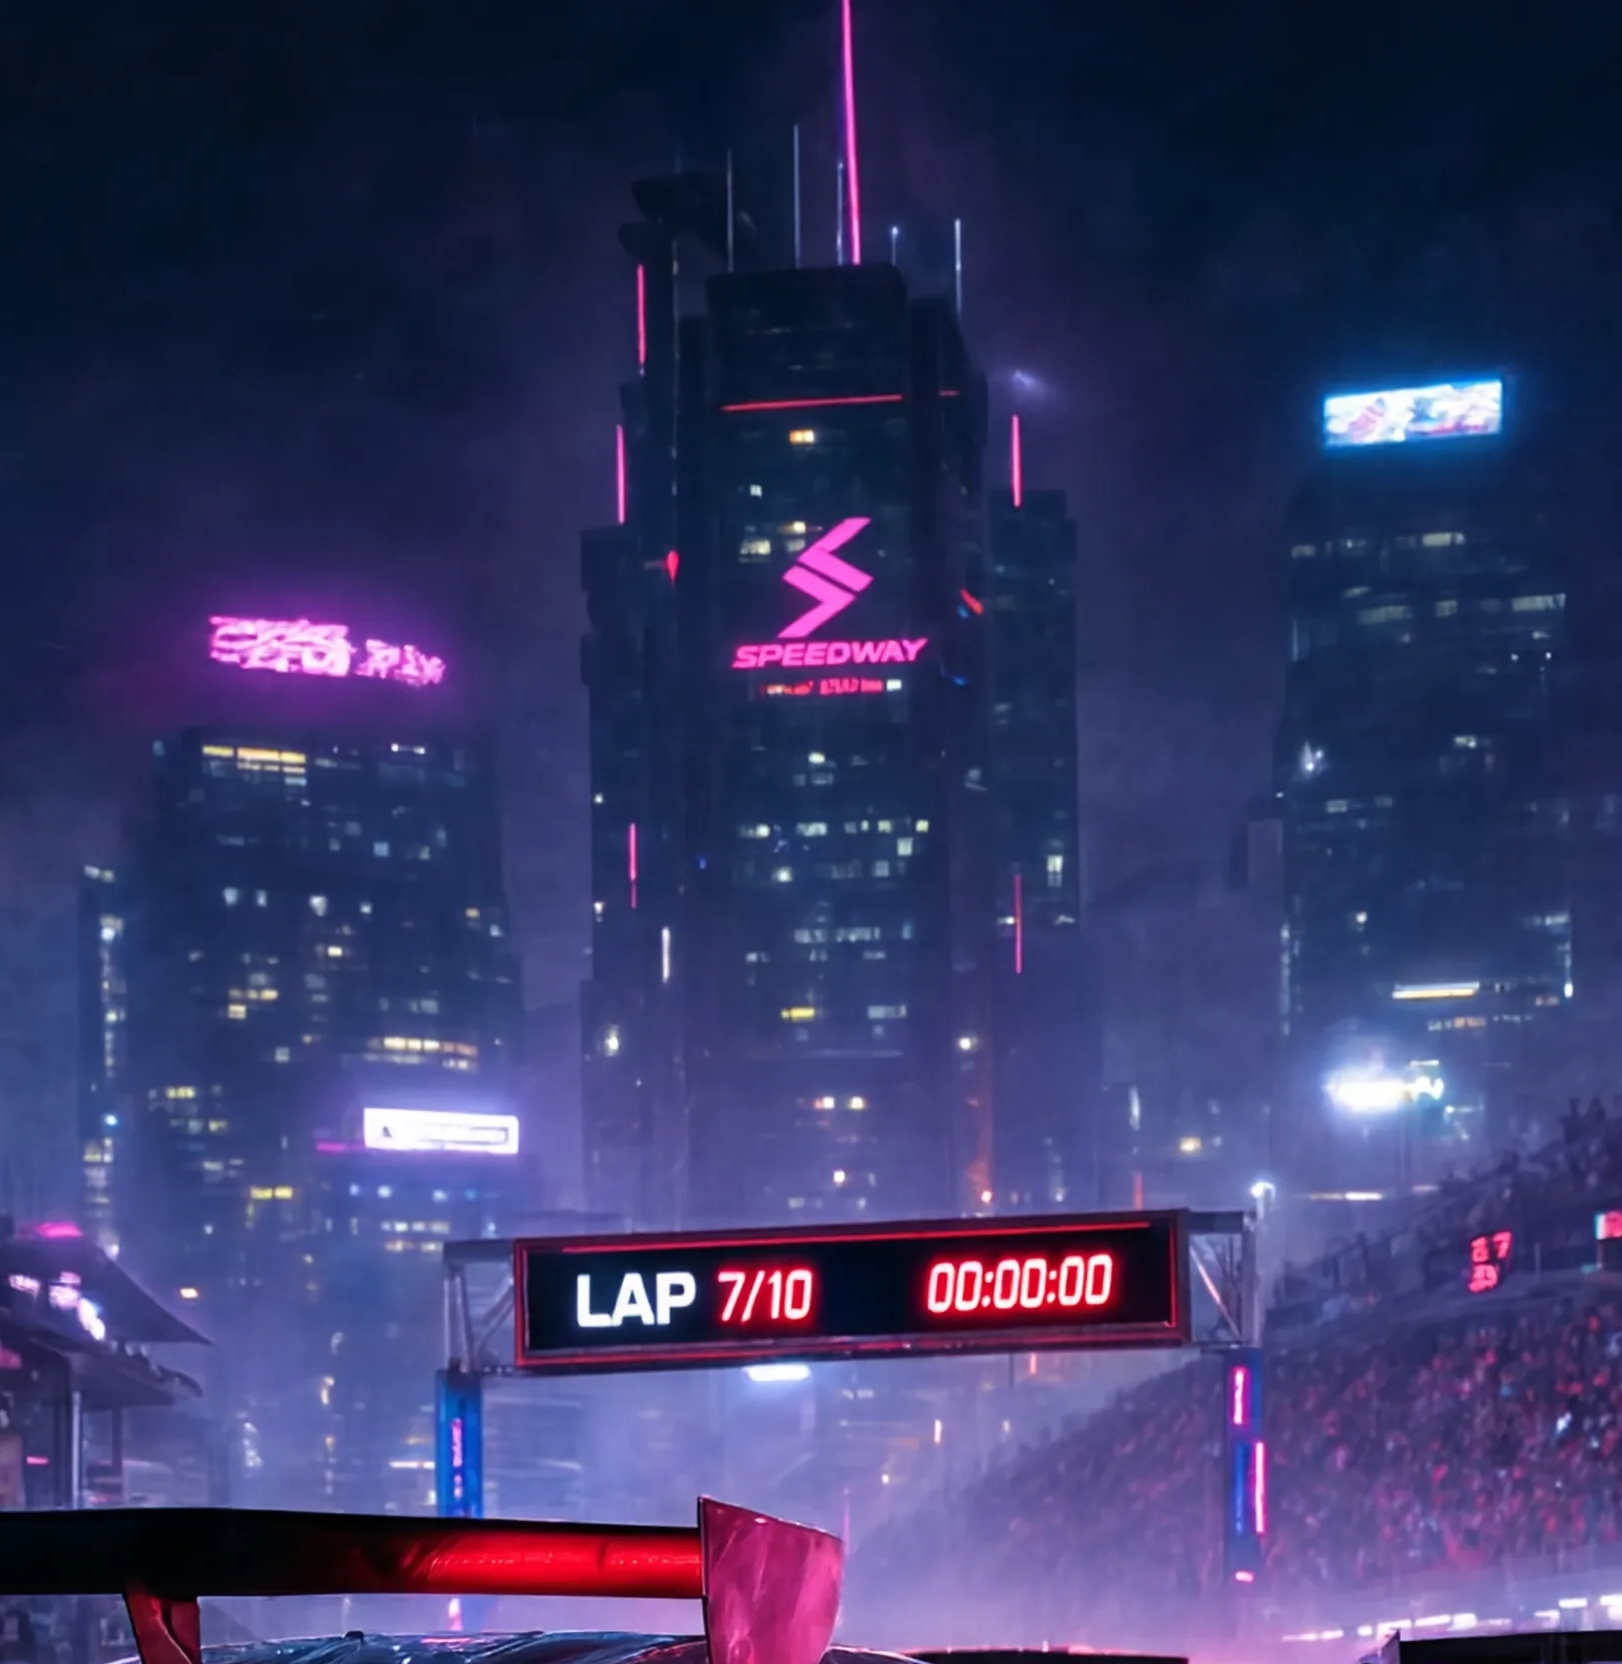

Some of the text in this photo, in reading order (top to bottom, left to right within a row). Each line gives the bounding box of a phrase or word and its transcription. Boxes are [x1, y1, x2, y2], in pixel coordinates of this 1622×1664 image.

[731, 638, 928, 669] SPEEDWAY
[576, 1251, 1114, 1328] LAP 7/10 00:00:00
